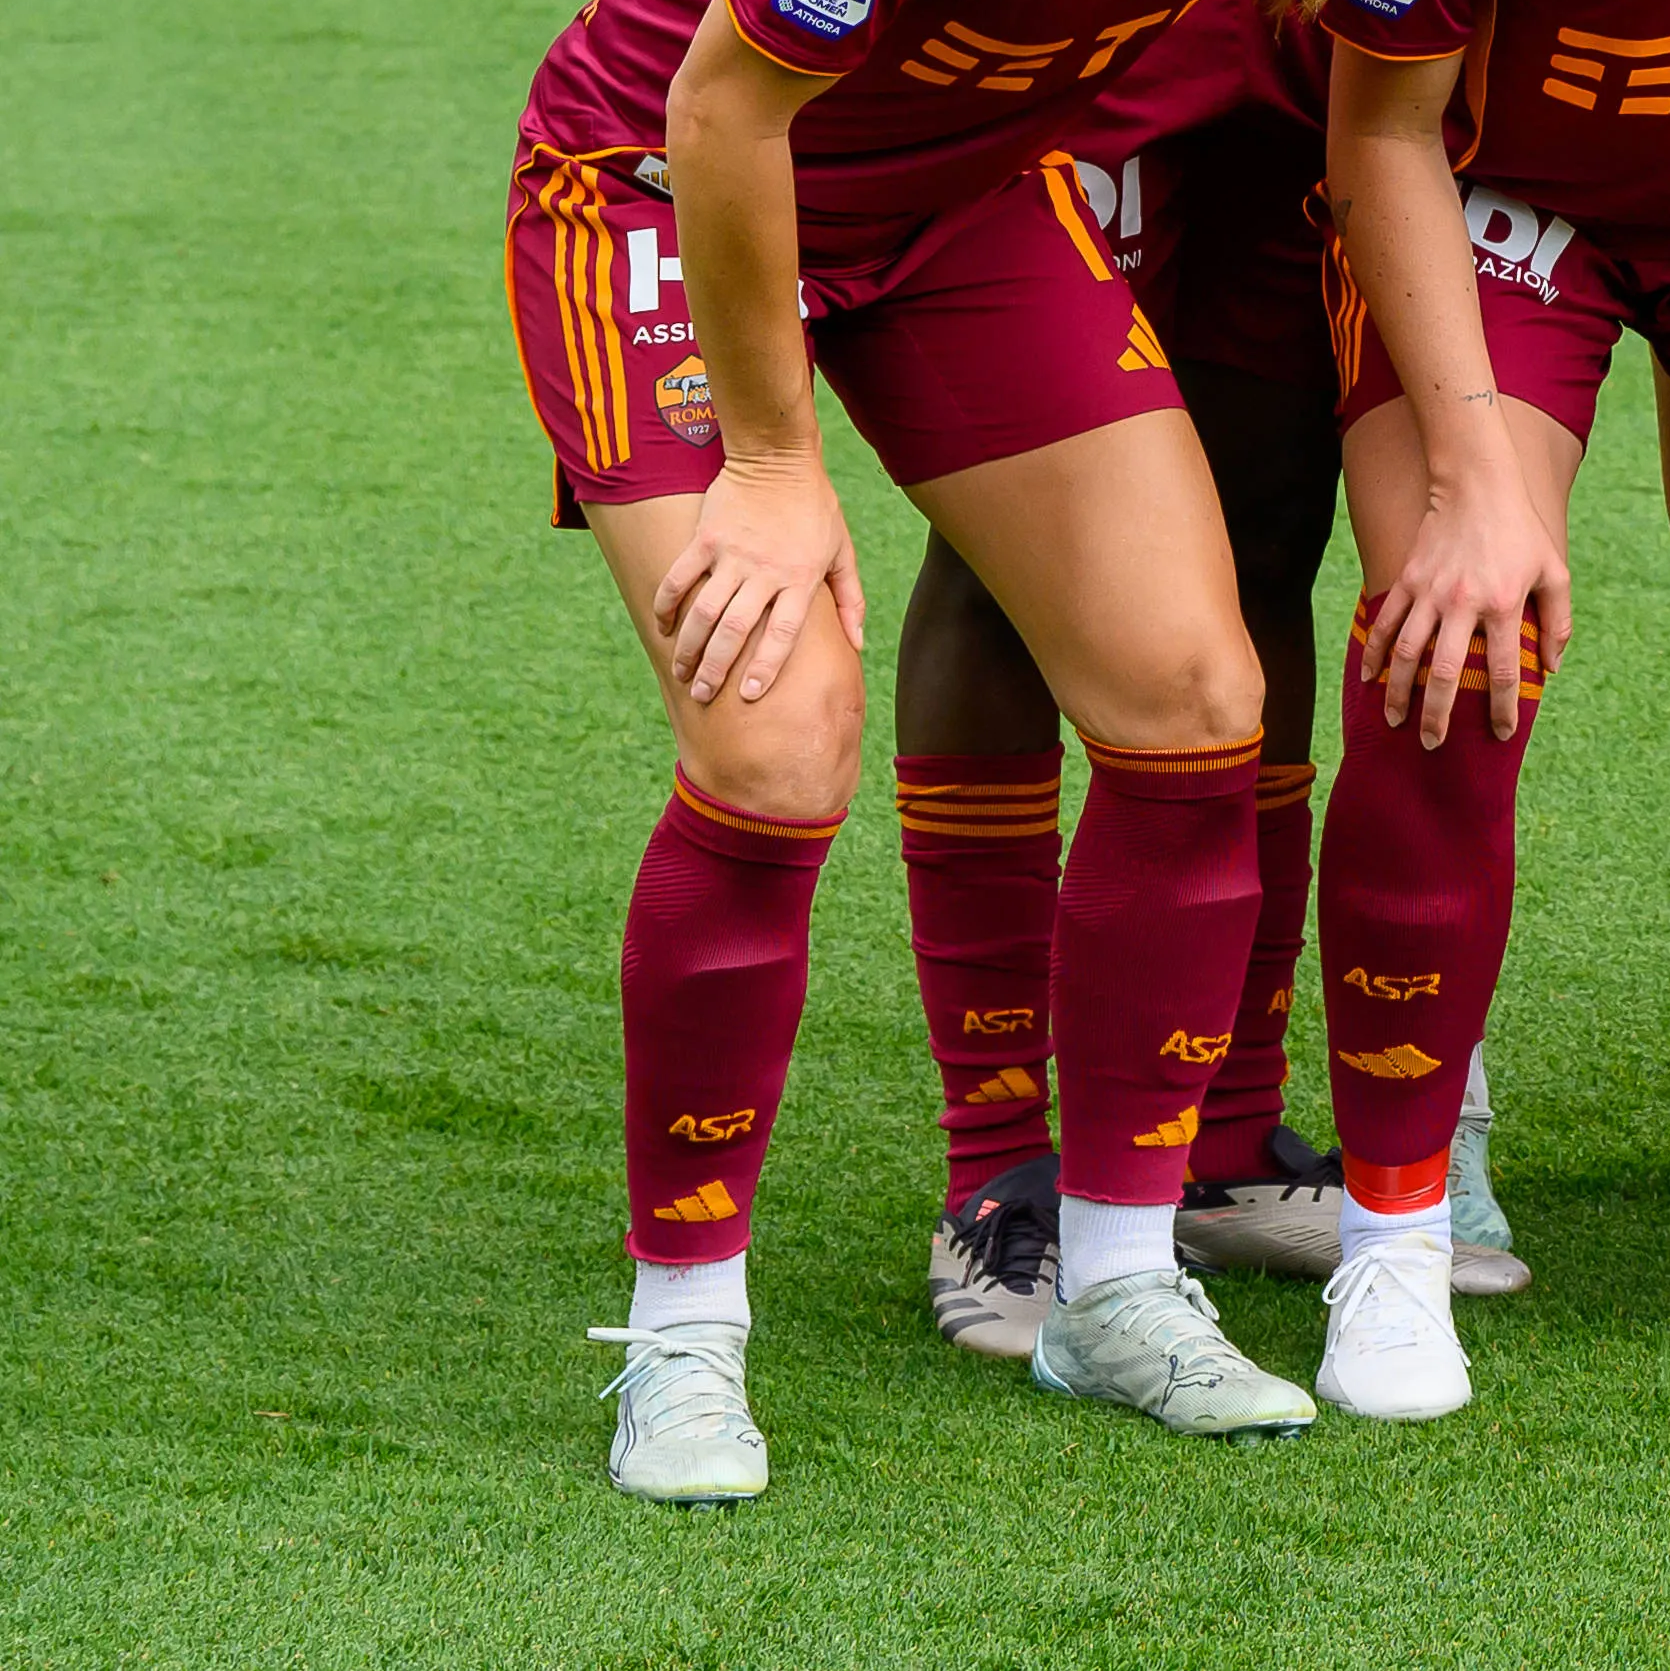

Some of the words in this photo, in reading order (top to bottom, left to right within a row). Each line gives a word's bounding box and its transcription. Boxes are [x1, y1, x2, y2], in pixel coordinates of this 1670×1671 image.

[792, 9, 841, 35] ATHORA
[1463, 183, 1575, 270] DI
[669, 406, 718, 426] ROM
[687, 424, 710, 435] 1927
[1343, 966, 1442, 1001] ASR
[963, 1008, 1034, 1034] ASR
[1159, 1030, 1233, 1065] ASR
[668, 1108, 757, 1143] ASR
